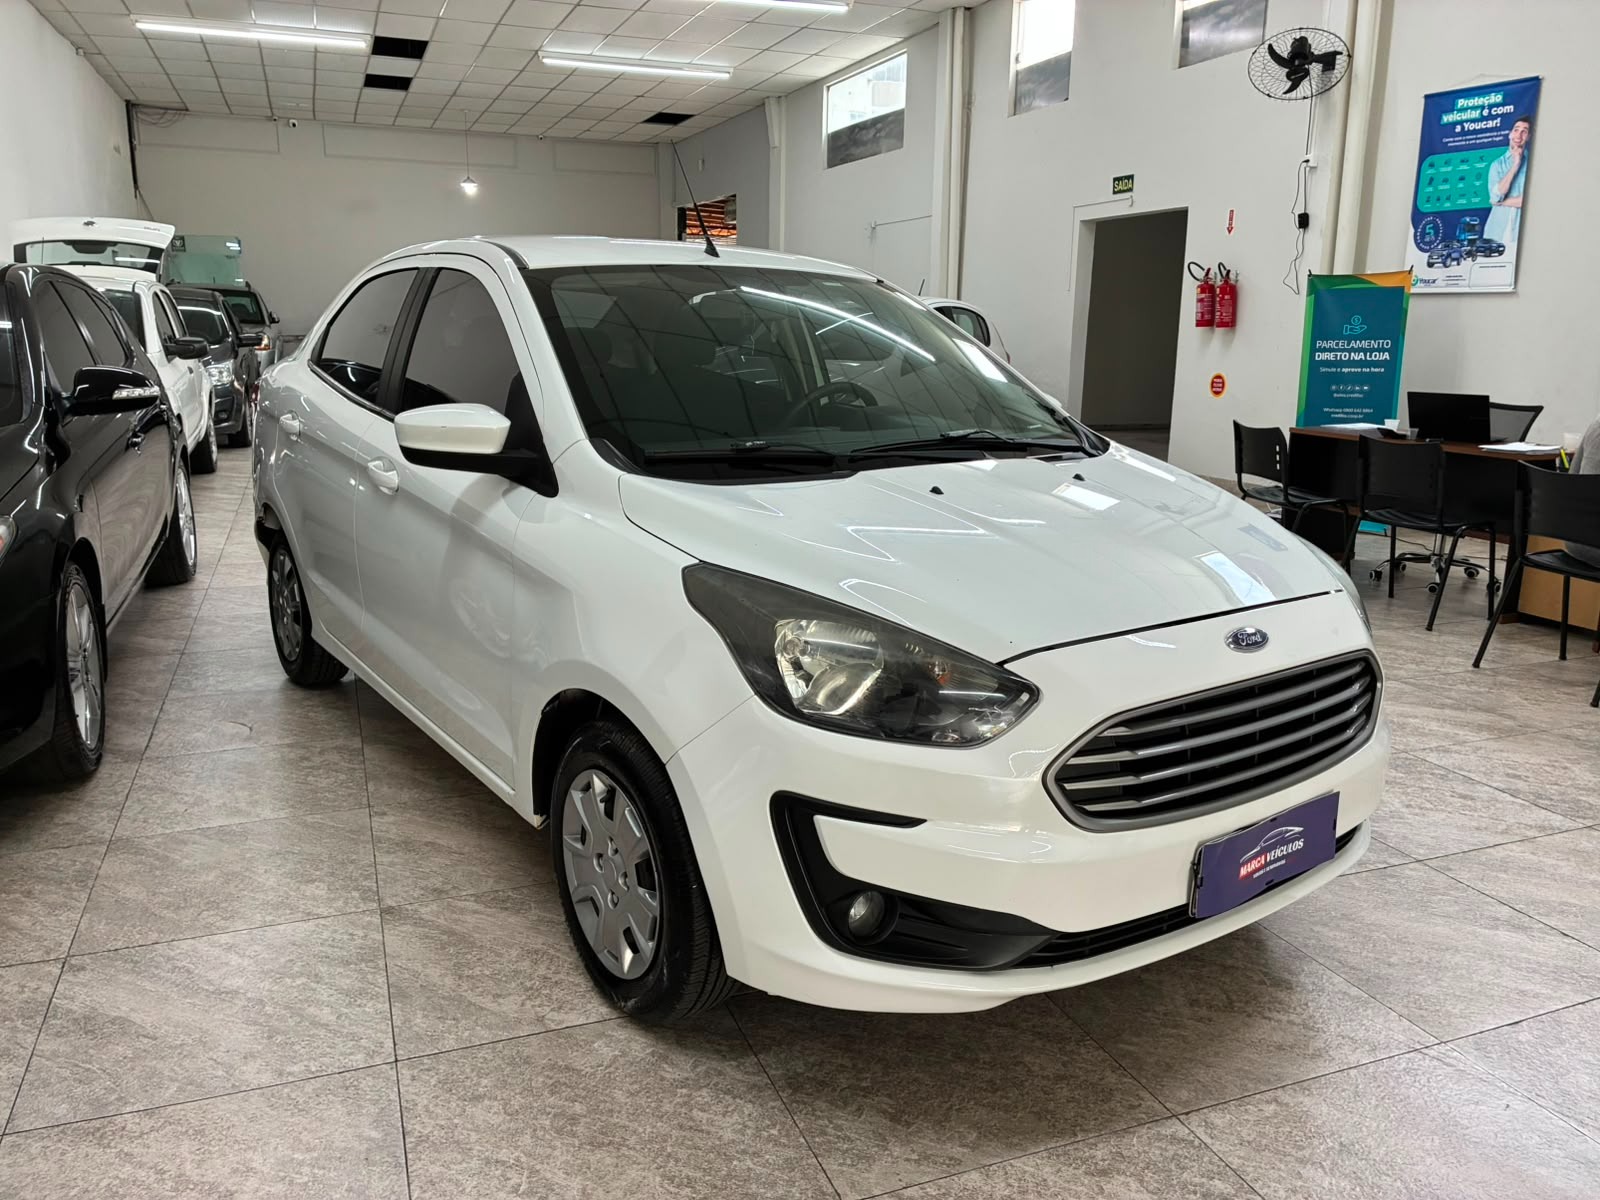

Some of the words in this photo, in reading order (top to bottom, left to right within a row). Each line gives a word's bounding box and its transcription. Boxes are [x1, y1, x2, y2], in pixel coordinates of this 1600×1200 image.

[1457, 92, 1502, 108] Proteção
[1442, 108, 1481, 123] veicular
[1482, 104, 1489, 116] é
[1491, 105, 1514, 115] com
[1463, 118, 1501, 130] Youcar!
[1114, 177, 1133, 192] SAÍDA
[1316, 340, 1391, 349] PARCELAMENTO
[1315, 352, 1349, 361] DIRETO
[1350, 352, 1365, 360] NA
[1366, 351, 1390, 360] LOJA
[1237, 631, 1262, 646] Ford
[1239, 854, 1266, 878] MARCA
[1266, 838, 1305, 862] VEÍCULOS
